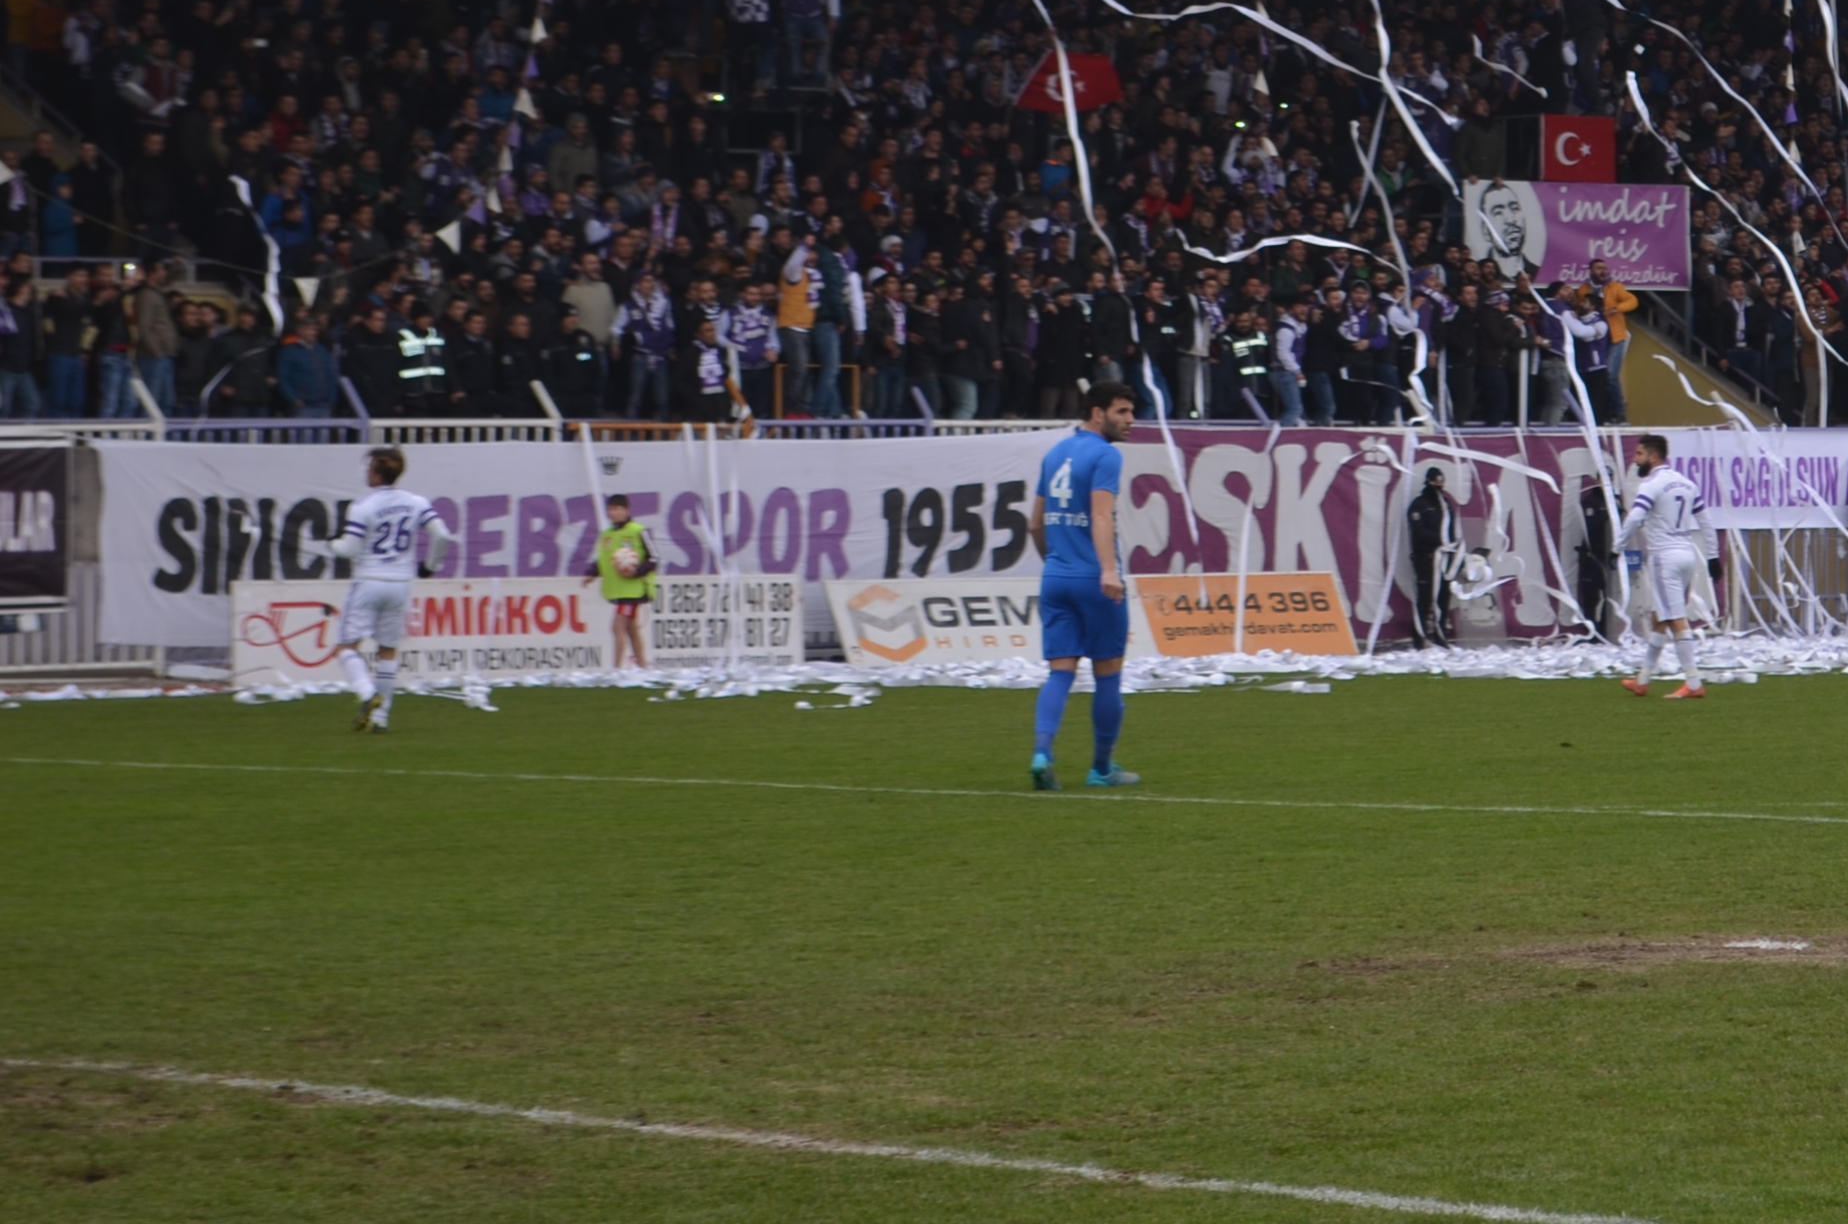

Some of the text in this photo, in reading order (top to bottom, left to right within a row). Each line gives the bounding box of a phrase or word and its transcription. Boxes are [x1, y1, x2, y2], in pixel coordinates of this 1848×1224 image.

[1558, 186, 1677, 227] imdat
[1588, 228, 1648, 262] reis
[1559, 263, 1679, 284] ölüsüzdür
[1049, 458, 1073, 508] 4
[1675, 495, 1685, 529] 7
[372, 516, 410, 554] 26
[883, 480, 1027, 579] 1955
[670, 583, 706, 613] 262
[1267, 591, 1331, 613] 396
[1163, 621, 1339, 640] gemakhidavat.com
